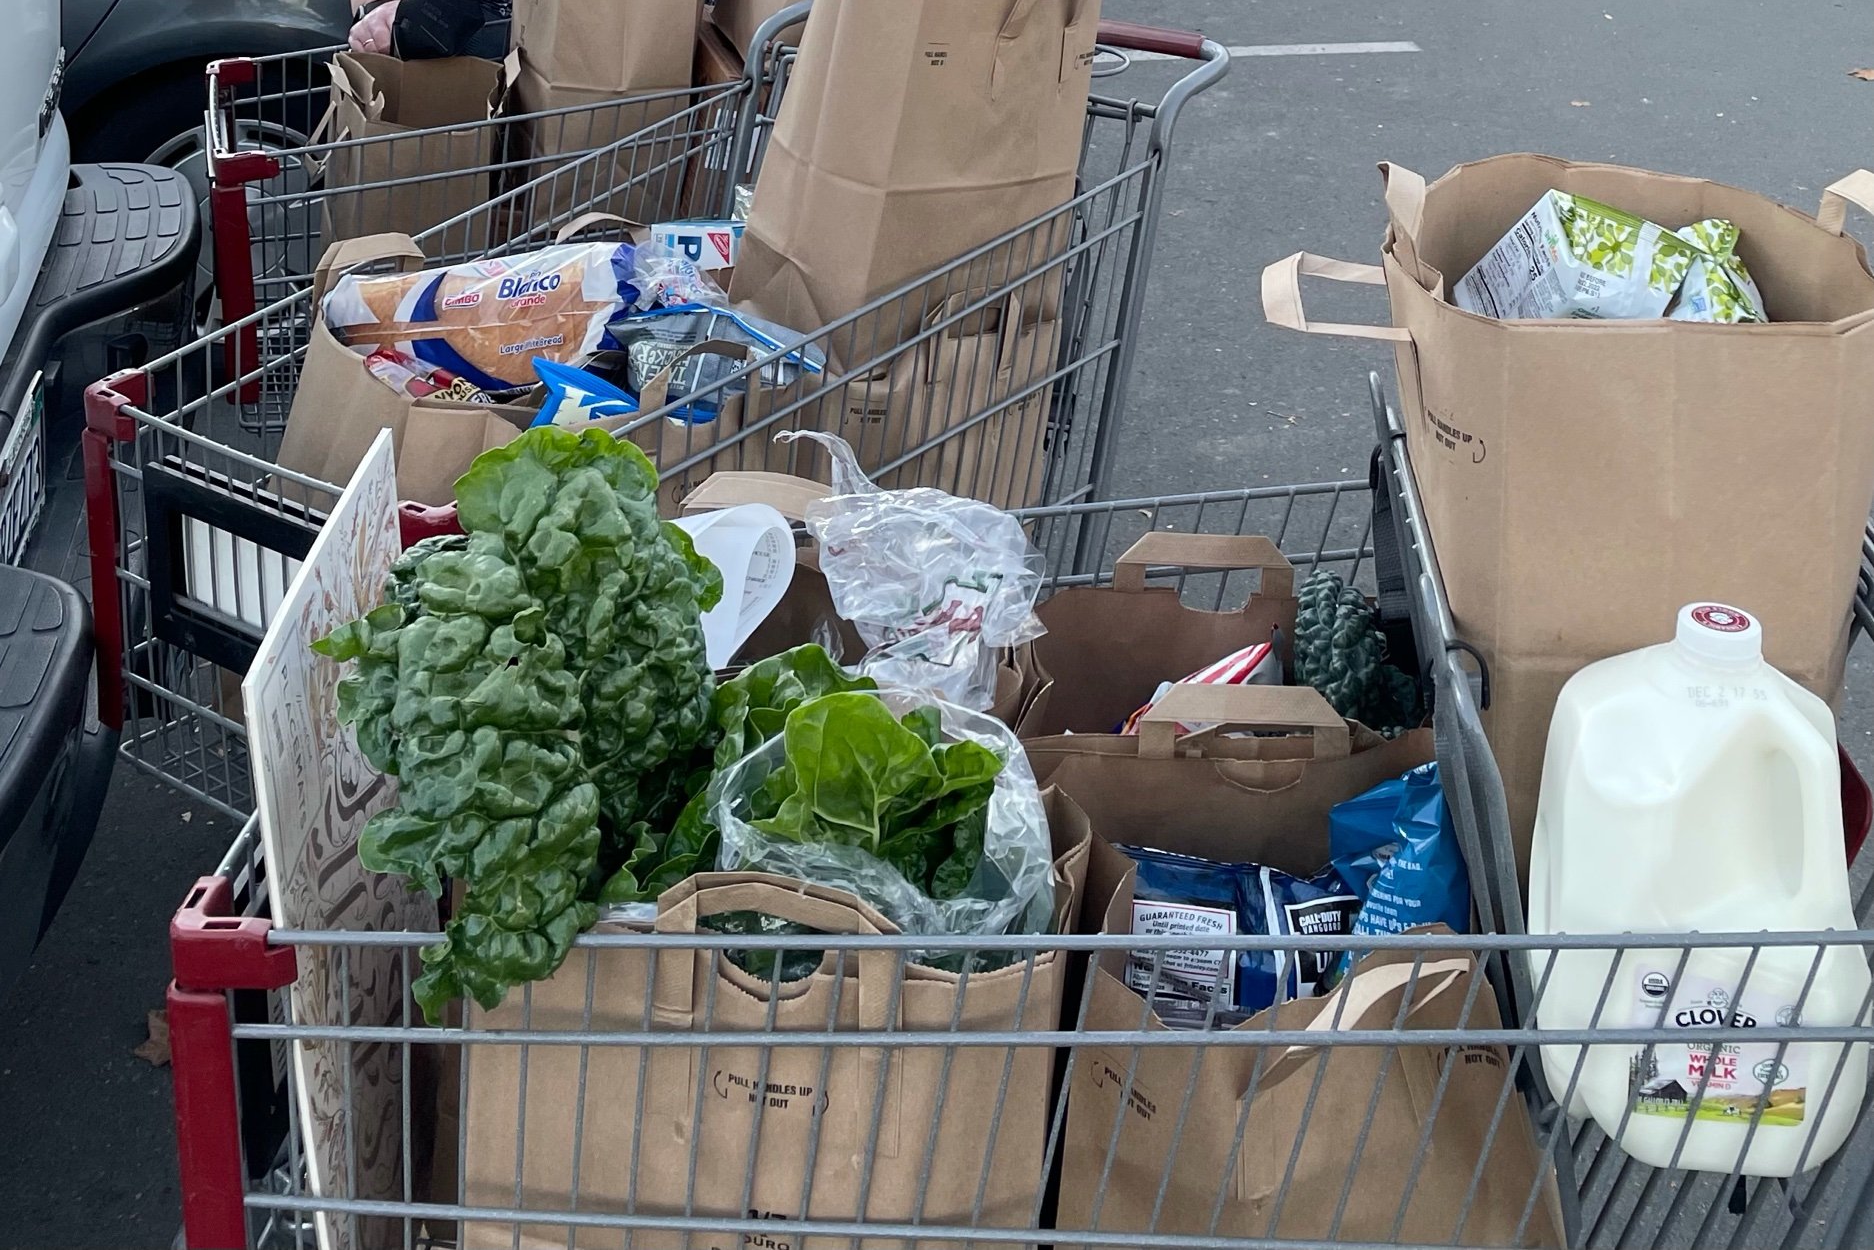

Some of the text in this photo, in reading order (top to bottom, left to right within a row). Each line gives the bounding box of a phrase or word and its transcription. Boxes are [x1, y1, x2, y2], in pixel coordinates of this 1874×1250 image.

[498, 273, 561, 299] Blanco
[500, 342, 524, 355] Large
[634, 360, 687, 386] TAER
[1687, 686, 1712, 699] DEC
[1718, 686, 1726, 698] 2
[281, 664, 307, 829] PLACEMATS
[1139, 911, 1223, 930] GUARANTEED FRESH
[1152, 920, 1210, 933] Until printed date
[1299, 910, 1342, 927] CALL DUTY
[1302, 922, 1341, 935] VANGUARD
[1191, 981, 1228, 994] Facs
[1675, 1009, 1757, 1029] CLOVER
[1687, 1042, 1741, 1055] ORGNIC
[1464, 1053, 1483, 1065] NOT
[1688, 1064, 1738, 1080] MLK
[728, 1073, 813, 1097] PULL HNDLES UP
[748, 1093, 789, 1109] NT OUT
